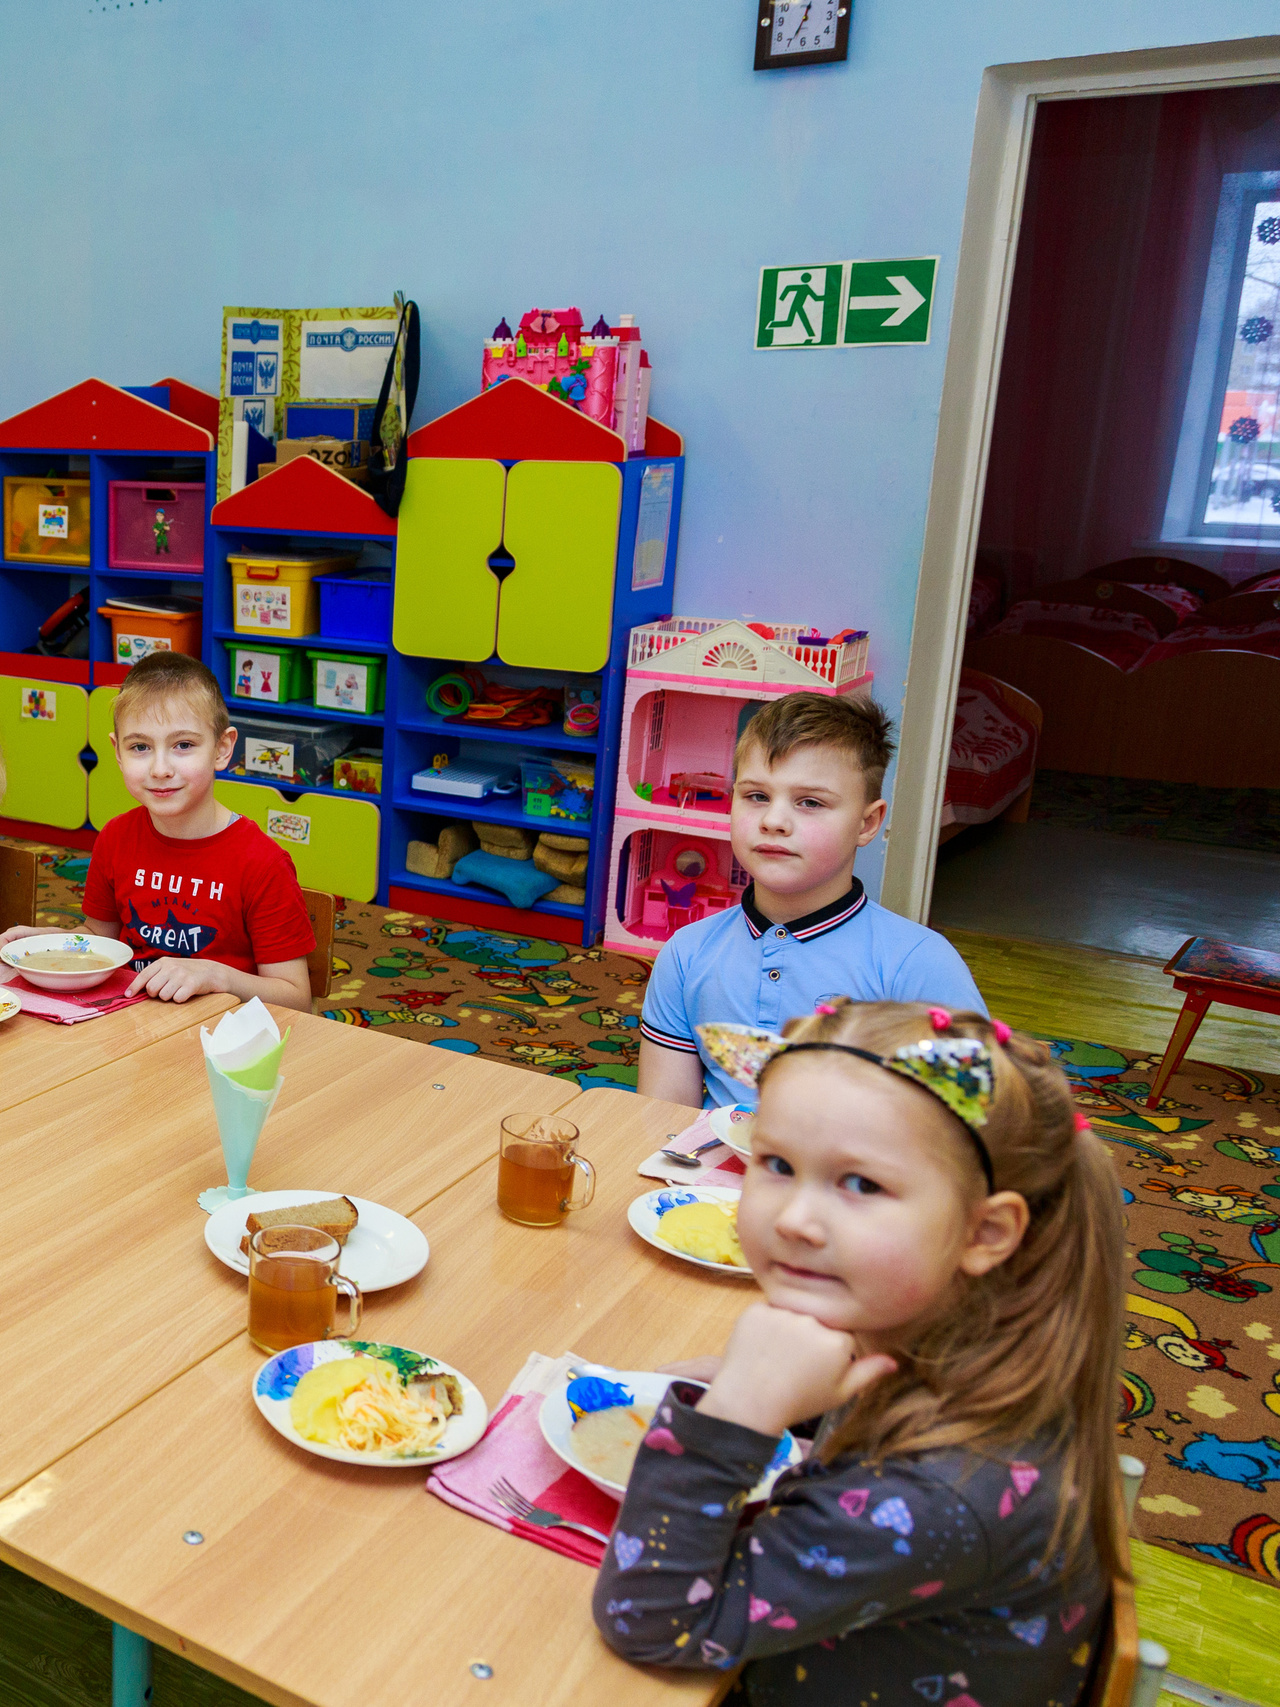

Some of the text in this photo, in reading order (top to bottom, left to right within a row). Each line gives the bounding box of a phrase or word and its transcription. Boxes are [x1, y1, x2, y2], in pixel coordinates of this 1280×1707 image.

[780, 3, 790, 13] 10
[826, 10, 832, 21] 3
[778, 17, 784, 26] 9
[823, 25, 830, 35] 4
[777, 32, 783, 42] 8
[800, 37, 806, 46] 6
[814, 35, 820, 45] 5
[787, 38, 793, 47] 7
[310, 334, 391, 345] ПОЧТА РОССИИ
[233, 362, 253, 373] ПОЧТА
[232, 375, 253, 386] РОССИИ
[135, 869, 224, 901] SOUTH
[151, 897, 199, 915] MIAMI
